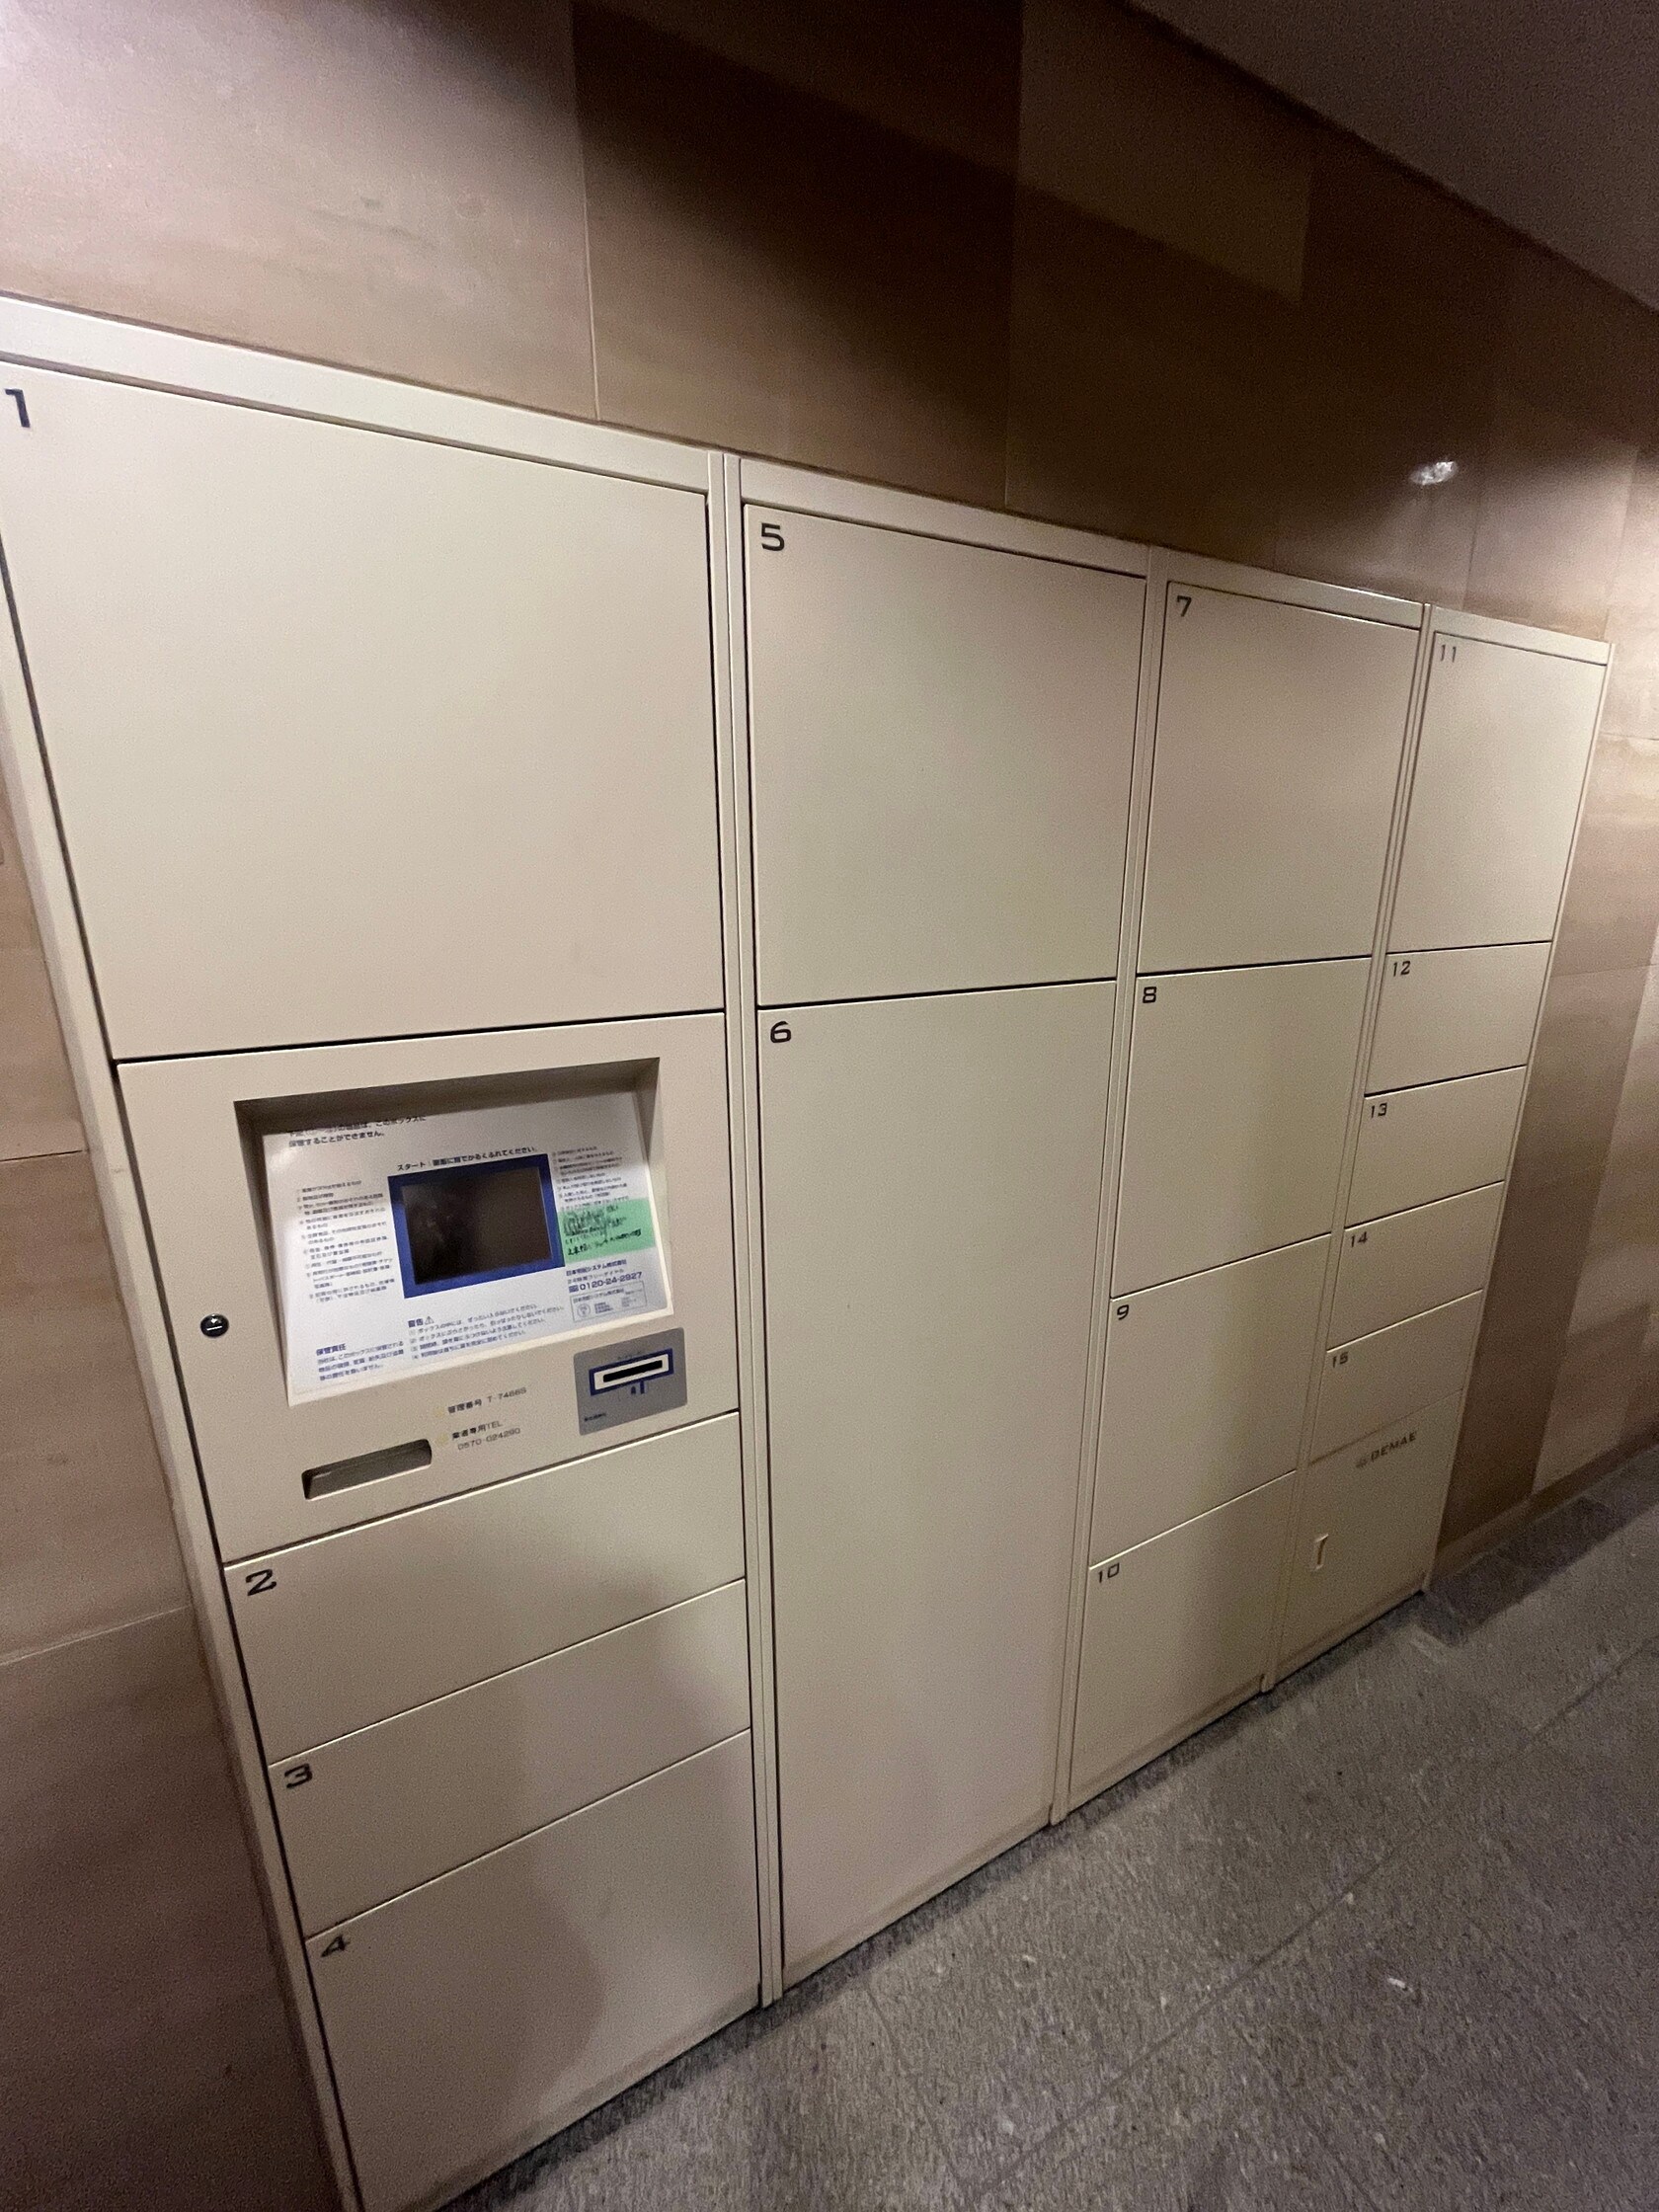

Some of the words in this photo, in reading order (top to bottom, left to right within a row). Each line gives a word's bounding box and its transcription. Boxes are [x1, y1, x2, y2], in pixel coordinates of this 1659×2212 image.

[4, 388, 31, 429] 1
[760, 523, 785, 552] 5
[1176, 594, 1192, 617] 7
[1440, 644, 1458, 663] 11
[1392, 961, 1411, 977] 12
[1143, 986, 1157, 1004] 8
[769, 1021, 792, 1044] 6
[1371, 1102, 1387, 1118] 13
[1351, 1231, 1369, 1248] 14
[1116, 1304, 1130, 1321] 9
[1333, 1351, 1349, 1368] 15
[1371, 1431, 1417, 1462] DEMAE
[245, 1568, 277, 1597] 2
[1098, 1562, 1120, 1584] 10
[284, 1763, 313, 1789] 3
[321, 1935, 348, 1958] 4
